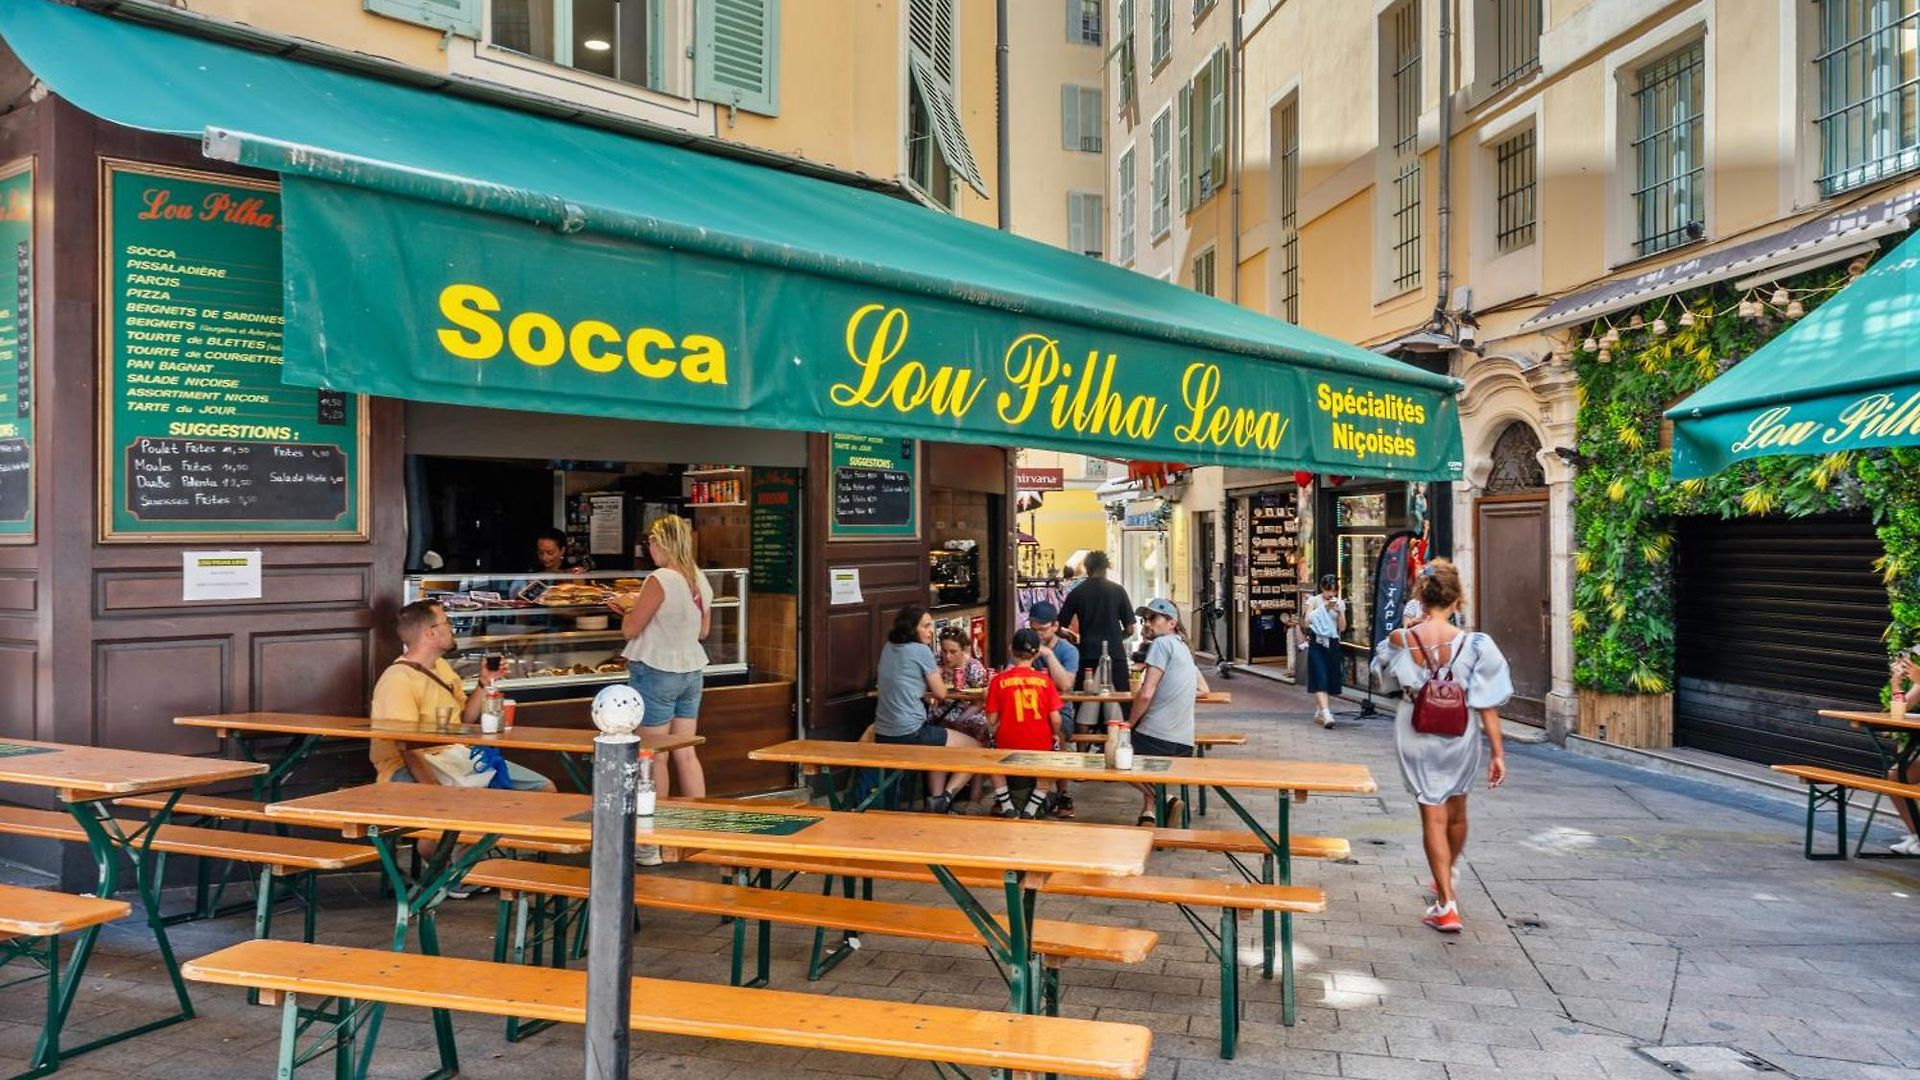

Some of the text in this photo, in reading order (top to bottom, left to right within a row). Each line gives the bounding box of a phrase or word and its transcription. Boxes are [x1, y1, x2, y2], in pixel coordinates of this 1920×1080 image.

[138, 189, 274, 228] Lou Pilha
[126, 245, 176, 259] SOCCA
[126, 260, 226, 278] PISSALADIÈRE
[126, 274, 180, 287] FARCIS
[126, 288, 170, 300] PIZZA
[126, 302, 285, 325] BEIGNETS DE SARDINES
[126, 317, 196, 330] BEIGNETS
[126, 331, 182, 343] TOURTE
[187, 336, 203, 345] de
[206, 337, 266, 350] BLETTES
[437, 283, 728, 385] Socca
[126, 345, 285, 365] TOURTE de COURGETTES
[127, 359, 214, 373] PAN BAGNAT
[127, 374, 180, 385] SALADE
[830, 304, 1289, 452] Lou Pilha Leva
[127, 388, 221, 401] ASSORTIMENT
[1317, 382, 1425, 424] Spécialités
[127, 402, 237, 416] TARTE du JOUR
[1732, 406, 1823, 453] Lou
[141, 439, 180, 454] Poulet
[1332, 422, 1416, 459] Niçoises
[134, 458, 173, 472] Moules
[1014, 688, 1042, 722] 19
